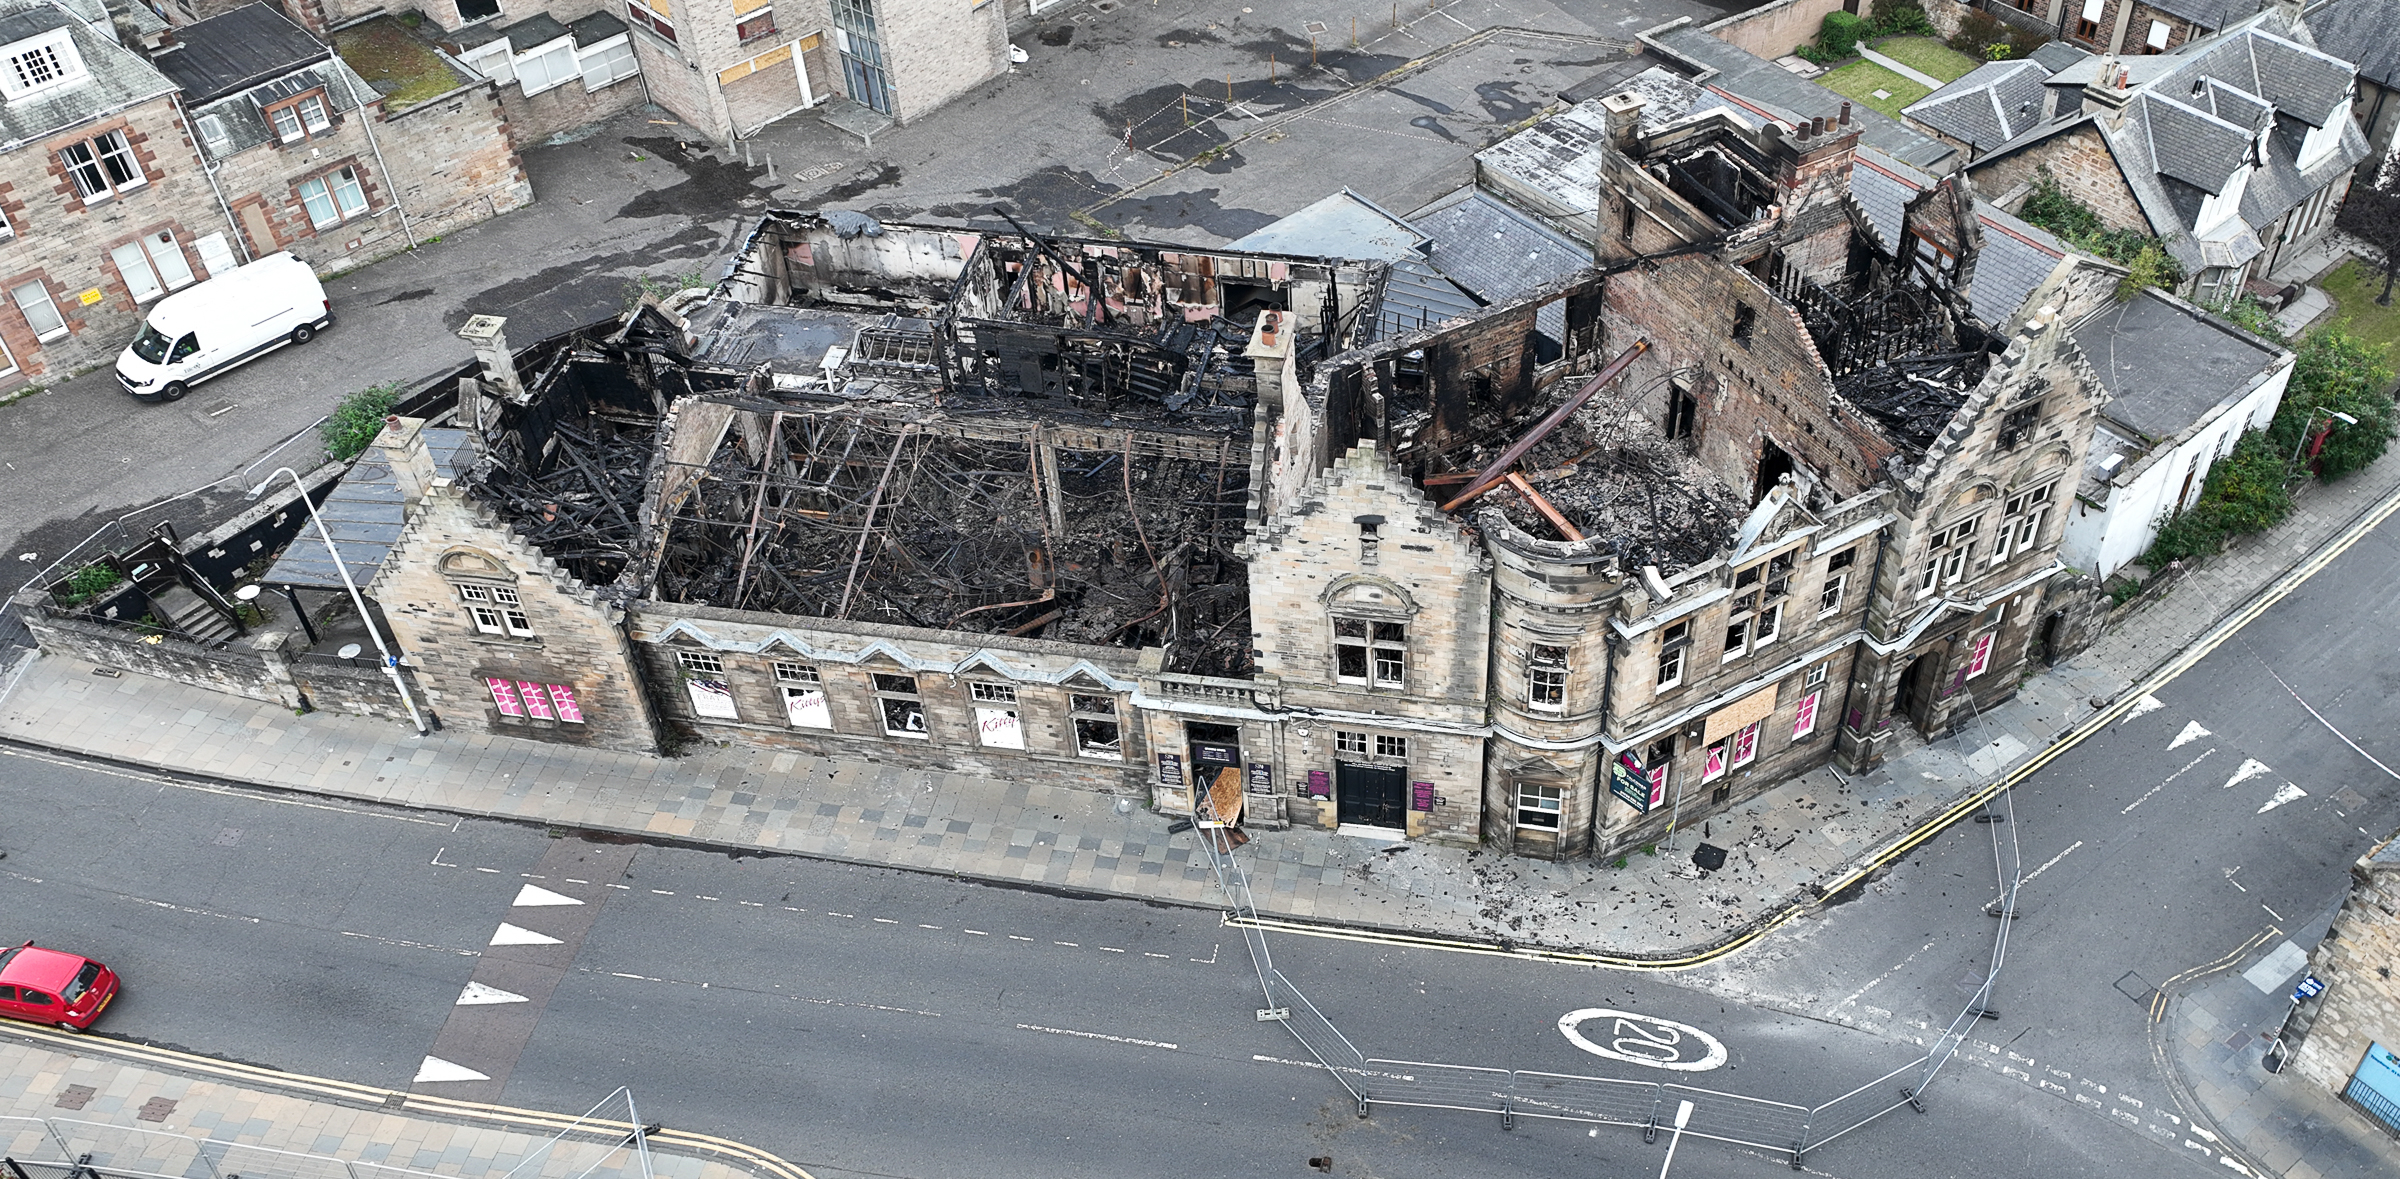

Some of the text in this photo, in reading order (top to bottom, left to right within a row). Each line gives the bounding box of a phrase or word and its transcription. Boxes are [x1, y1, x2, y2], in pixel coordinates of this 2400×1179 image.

[1616, 776, 1630, 788] FOR
[1629, 783, 1646, 799] SALE
[1612, 1018, 1681, 1062] 20
